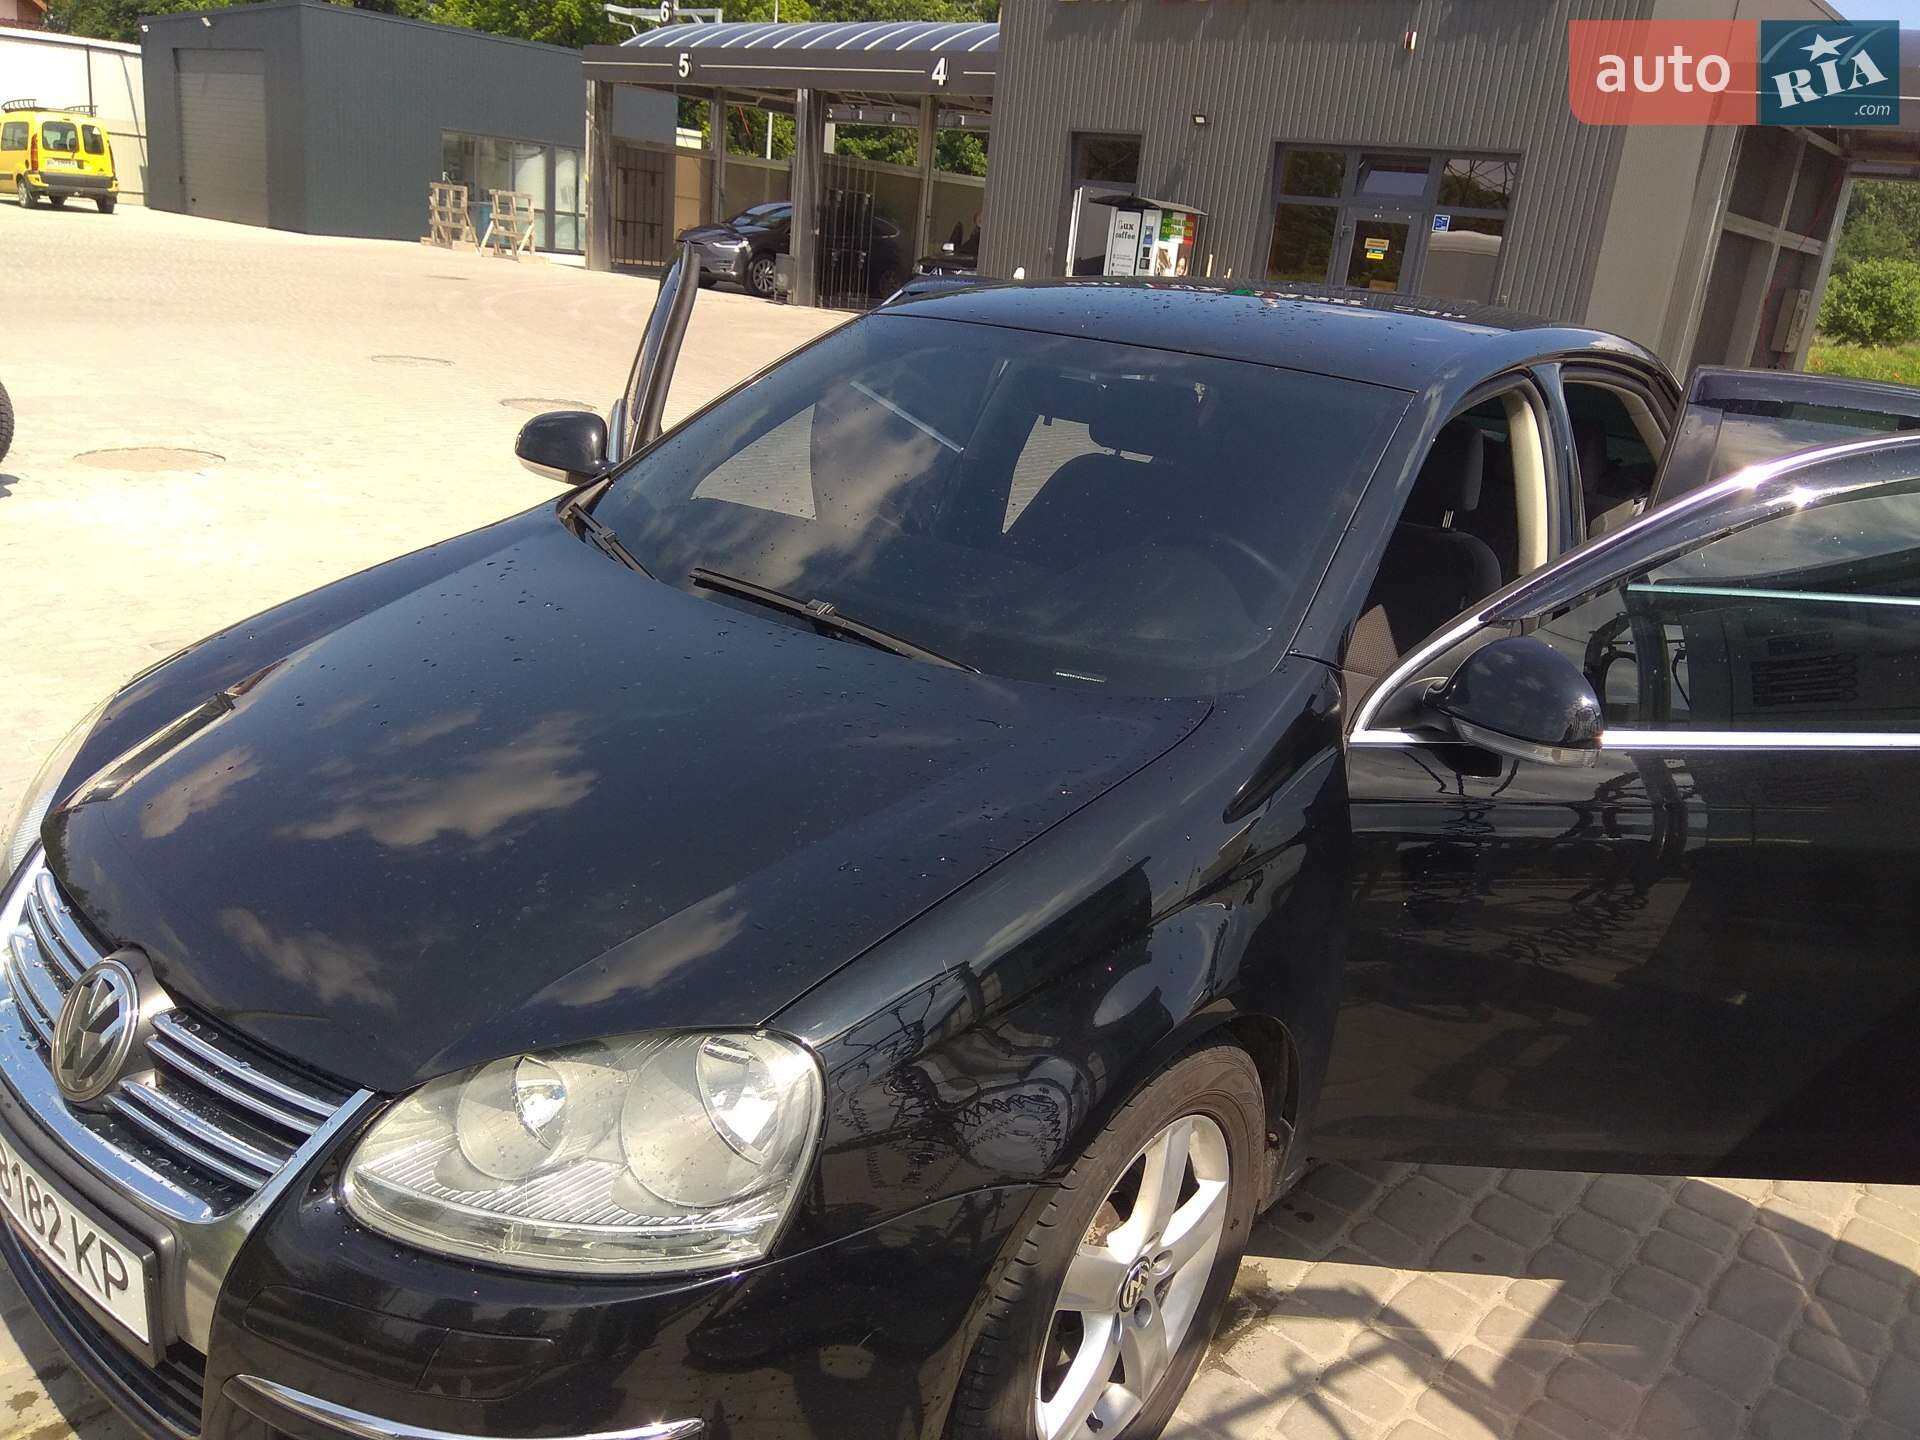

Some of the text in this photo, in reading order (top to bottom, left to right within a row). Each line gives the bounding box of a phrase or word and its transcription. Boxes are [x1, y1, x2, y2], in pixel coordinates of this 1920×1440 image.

[660, 1, 671, 22] 6
[678, 52, 692, 78] 5
[931, 57, 948, 86] 4
